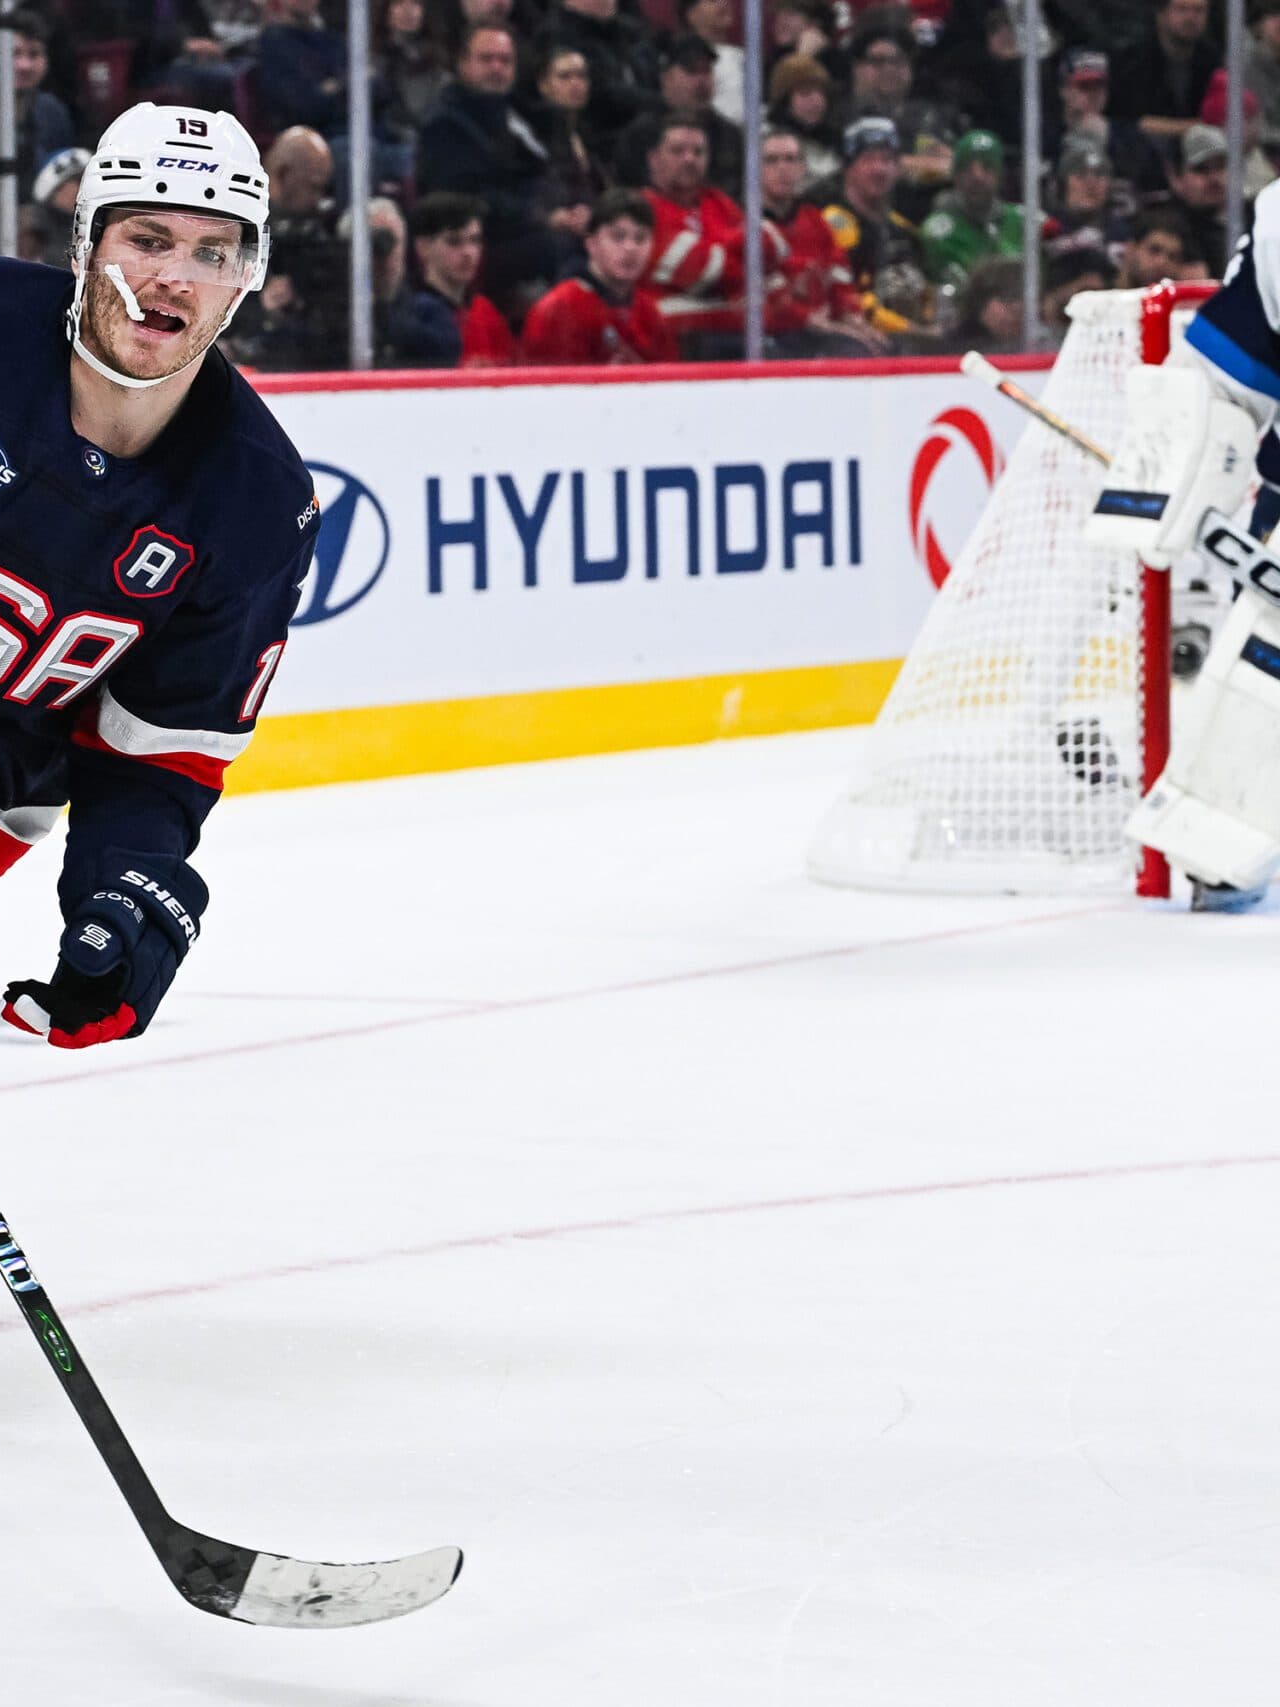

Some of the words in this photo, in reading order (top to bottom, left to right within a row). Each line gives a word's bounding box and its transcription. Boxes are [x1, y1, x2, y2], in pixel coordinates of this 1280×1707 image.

[176, 118, 208, 137] 19
[156, 157, 220, 173] CCM
[426, 459, 861, 594] HYUNDAI
[126, 541, 177, 589] A
